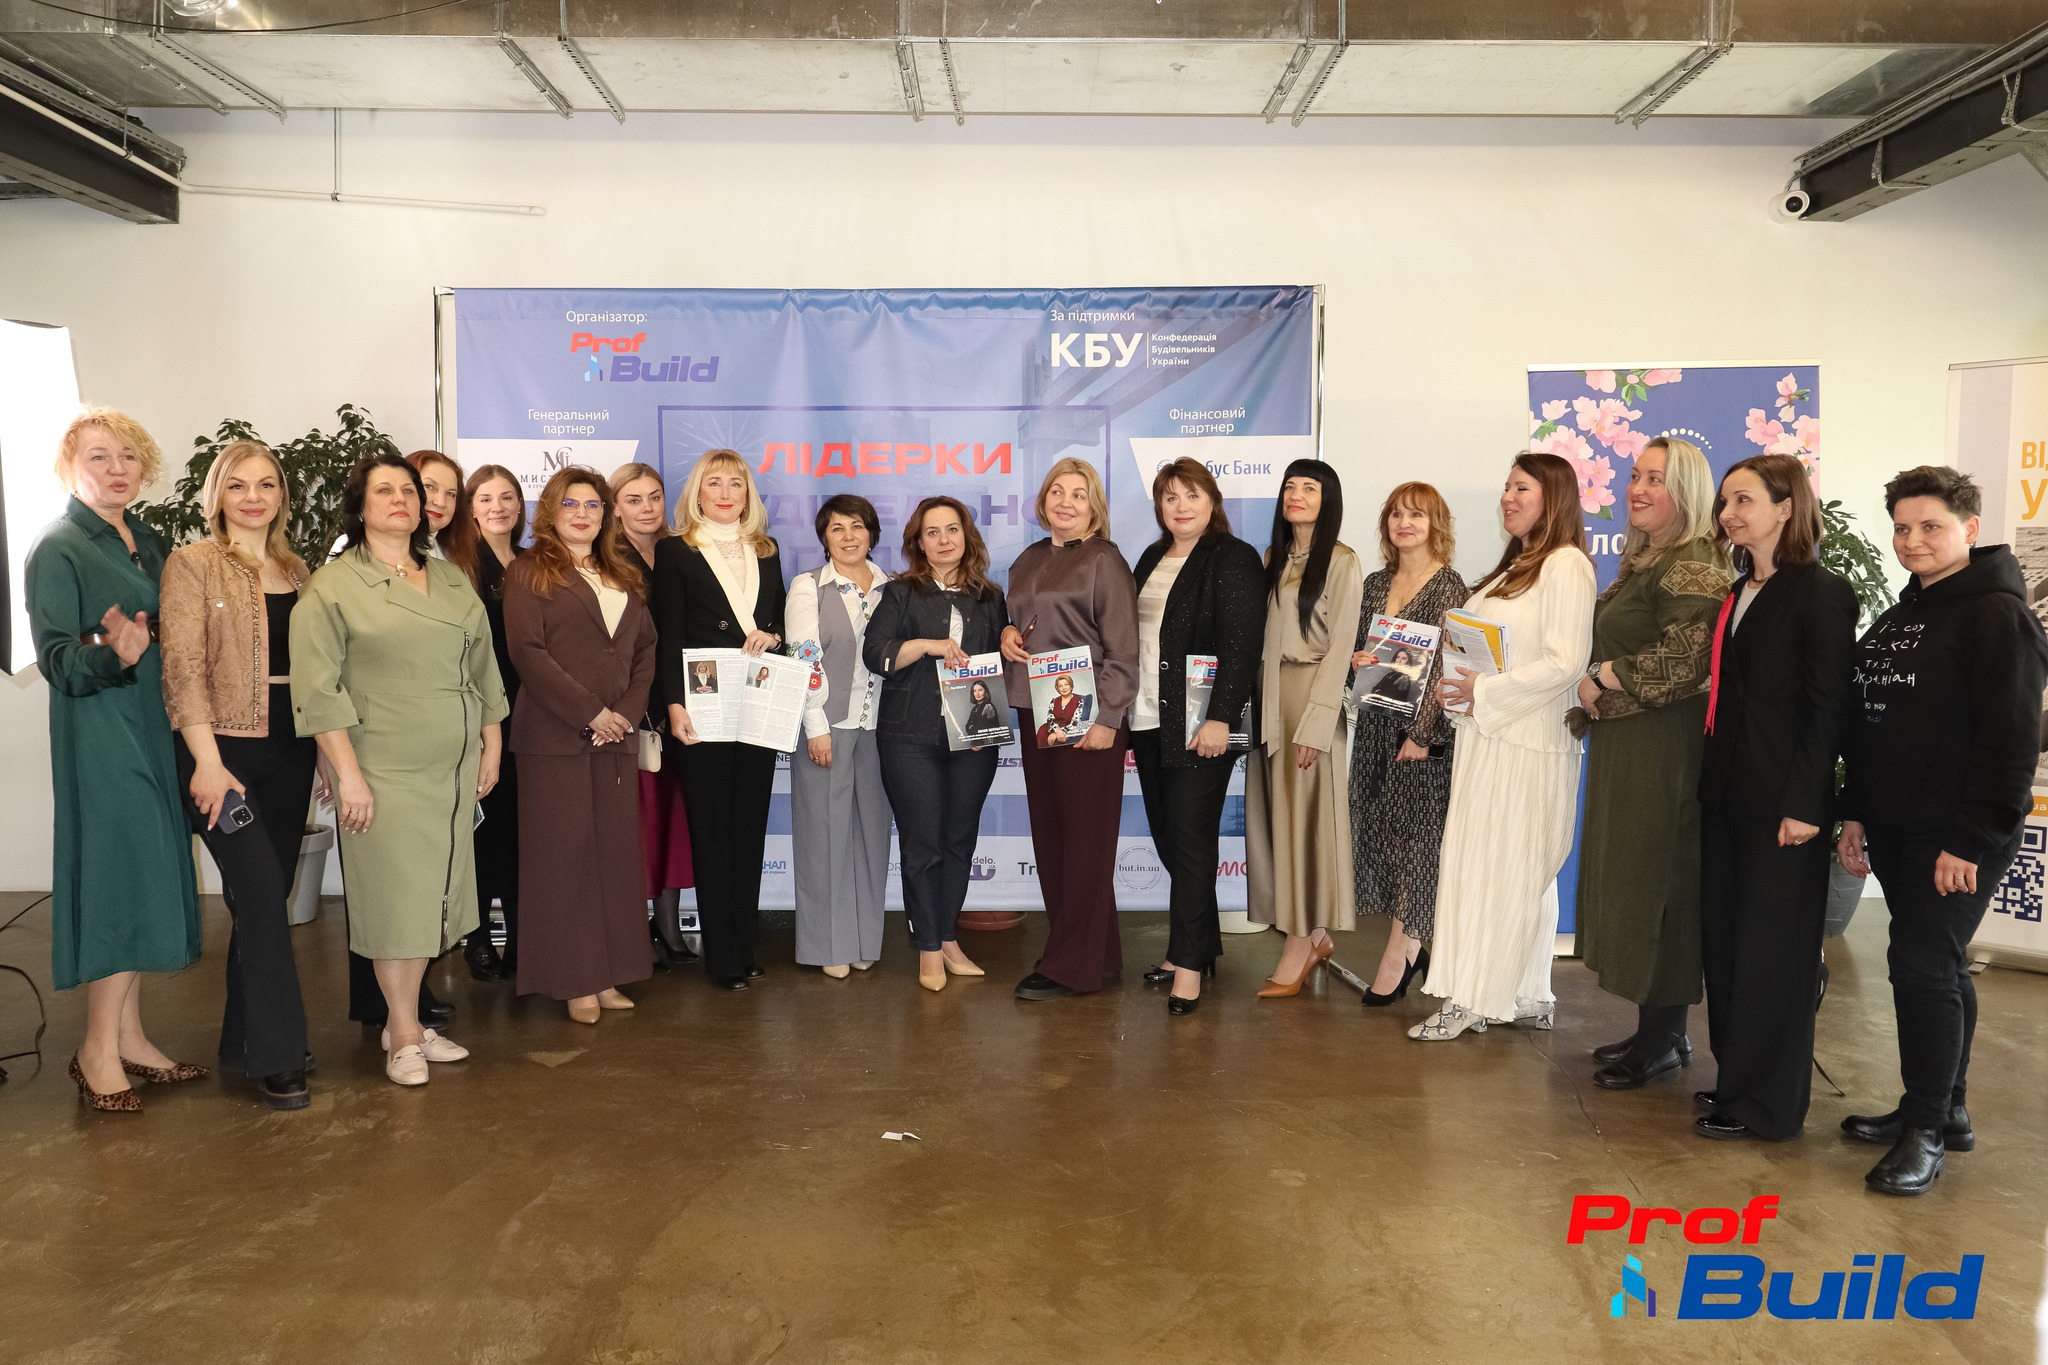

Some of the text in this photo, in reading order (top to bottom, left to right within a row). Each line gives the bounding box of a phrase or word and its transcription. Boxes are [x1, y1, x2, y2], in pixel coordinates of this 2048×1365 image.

[566, 310, 648, 325] Організатор:
[1050, 310, 1135, 324] За підтримки
[570, 332, 647, 353] Prof
[1152, 333, 1217, 343] Конфедерація
[1051, 333, 1144, 368] КБУ
[1152, 345, 1216, 355] Будівельників
[1152, 357, 1190, 367] України
[610, 356, 720, 382] Build
[528, 409, 609, 422] Генеральний
[1169, 407, 1246, 420] Фінансовий
[543, 425, 595, 436] партнер
[1181, 423, 1235, 436] партнер
[758, 442, 1012, 478] ЛІДЕРКИ
[2021, 441, 2048, 471] ВІ
[1206, 460, 1272, 479] бус Банк
[1584, 526, 1628, 556] ло
[1377, 618, 1407, 631] Prof
[1389, 631, 1432, 648] Build
[1031, 653, 1059, 666] Prof
[1047, 657, 1089, 674] Build
[959, 664, 998, 678] Build
[762, 861, 786, 870] НАЛ
[1017, 862, 1036, 875] Tr
[1119, 864, 1160, 872] but.in.ua
